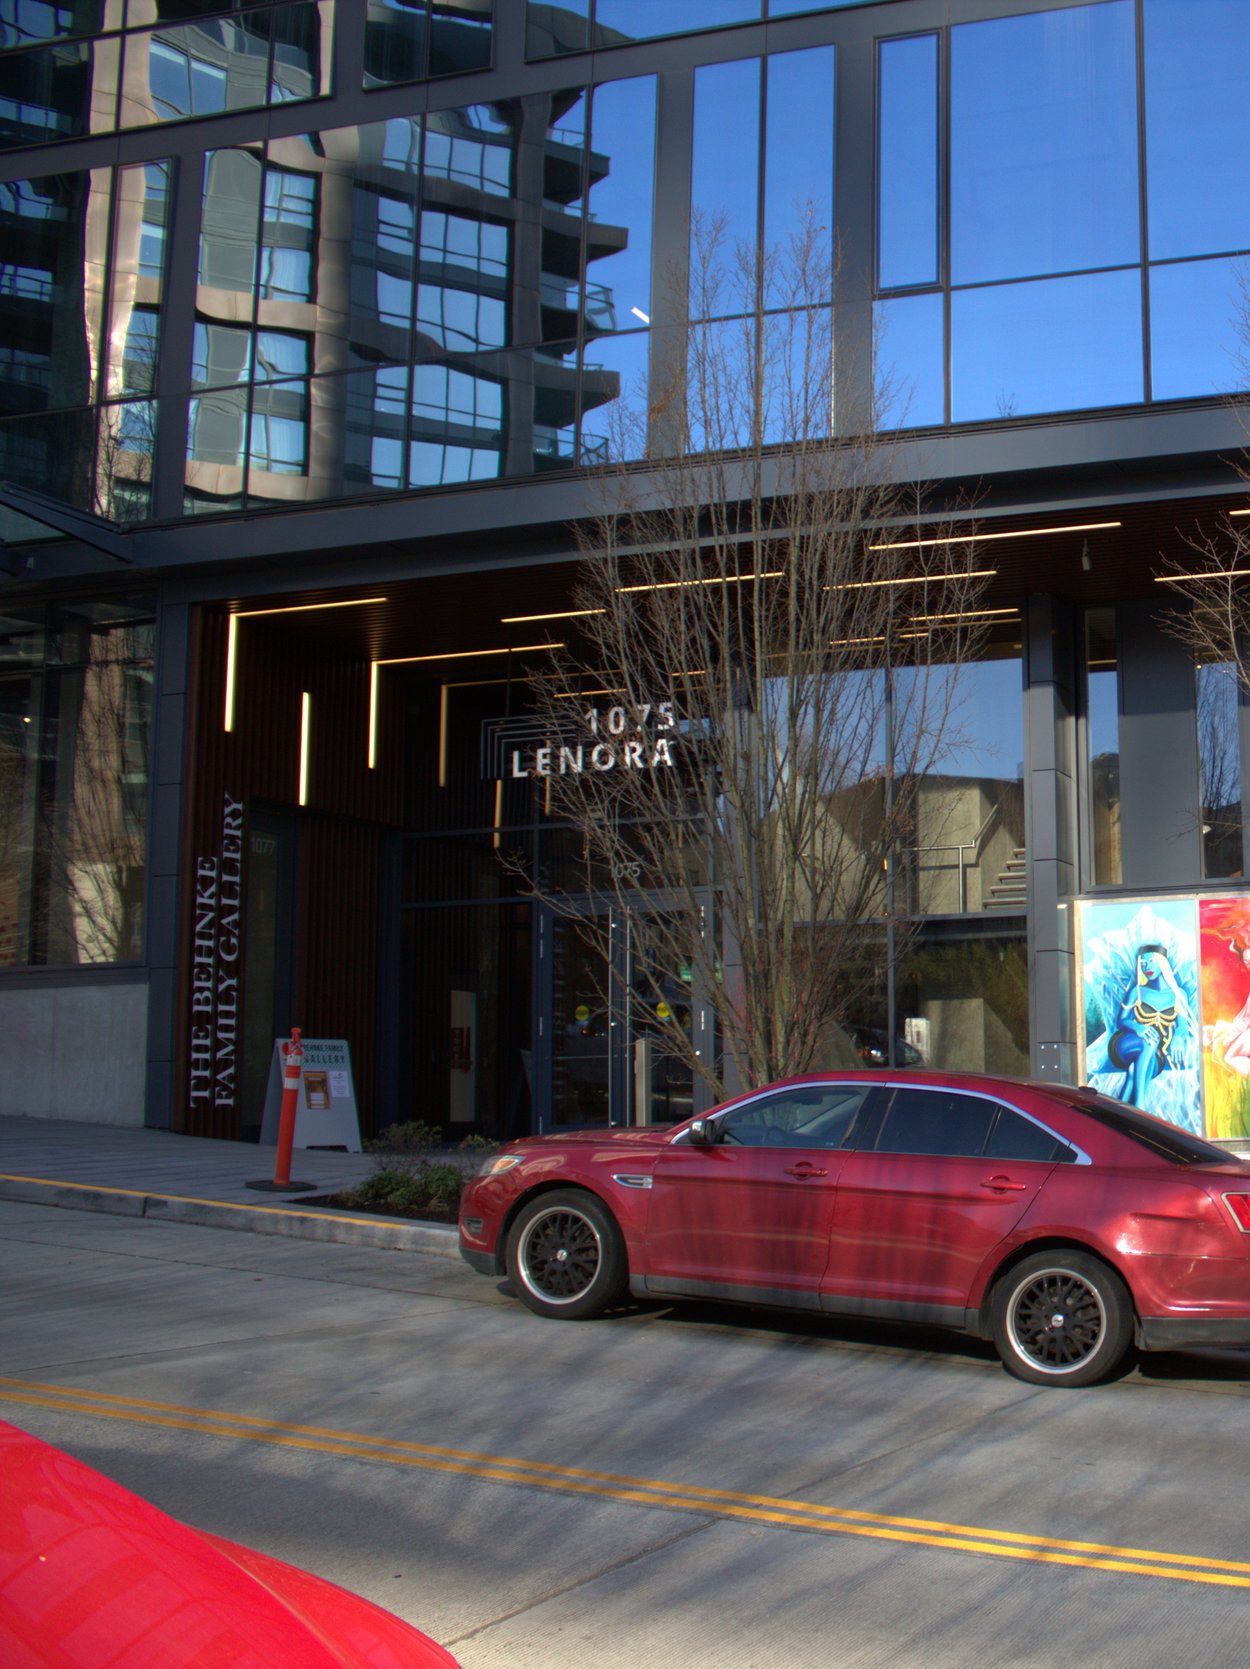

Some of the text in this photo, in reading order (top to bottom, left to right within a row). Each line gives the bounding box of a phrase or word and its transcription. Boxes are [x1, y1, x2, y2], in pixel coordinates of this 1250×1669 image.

[585, 701, 675, 735] 1075
[512, 738, 674, 778] LENORA
[251, 836, 275, 856] 1077
[215, 791, 244, 1108] FAMILY GALLERY
[190, 857, 217, 1108] THE BEHNKE
